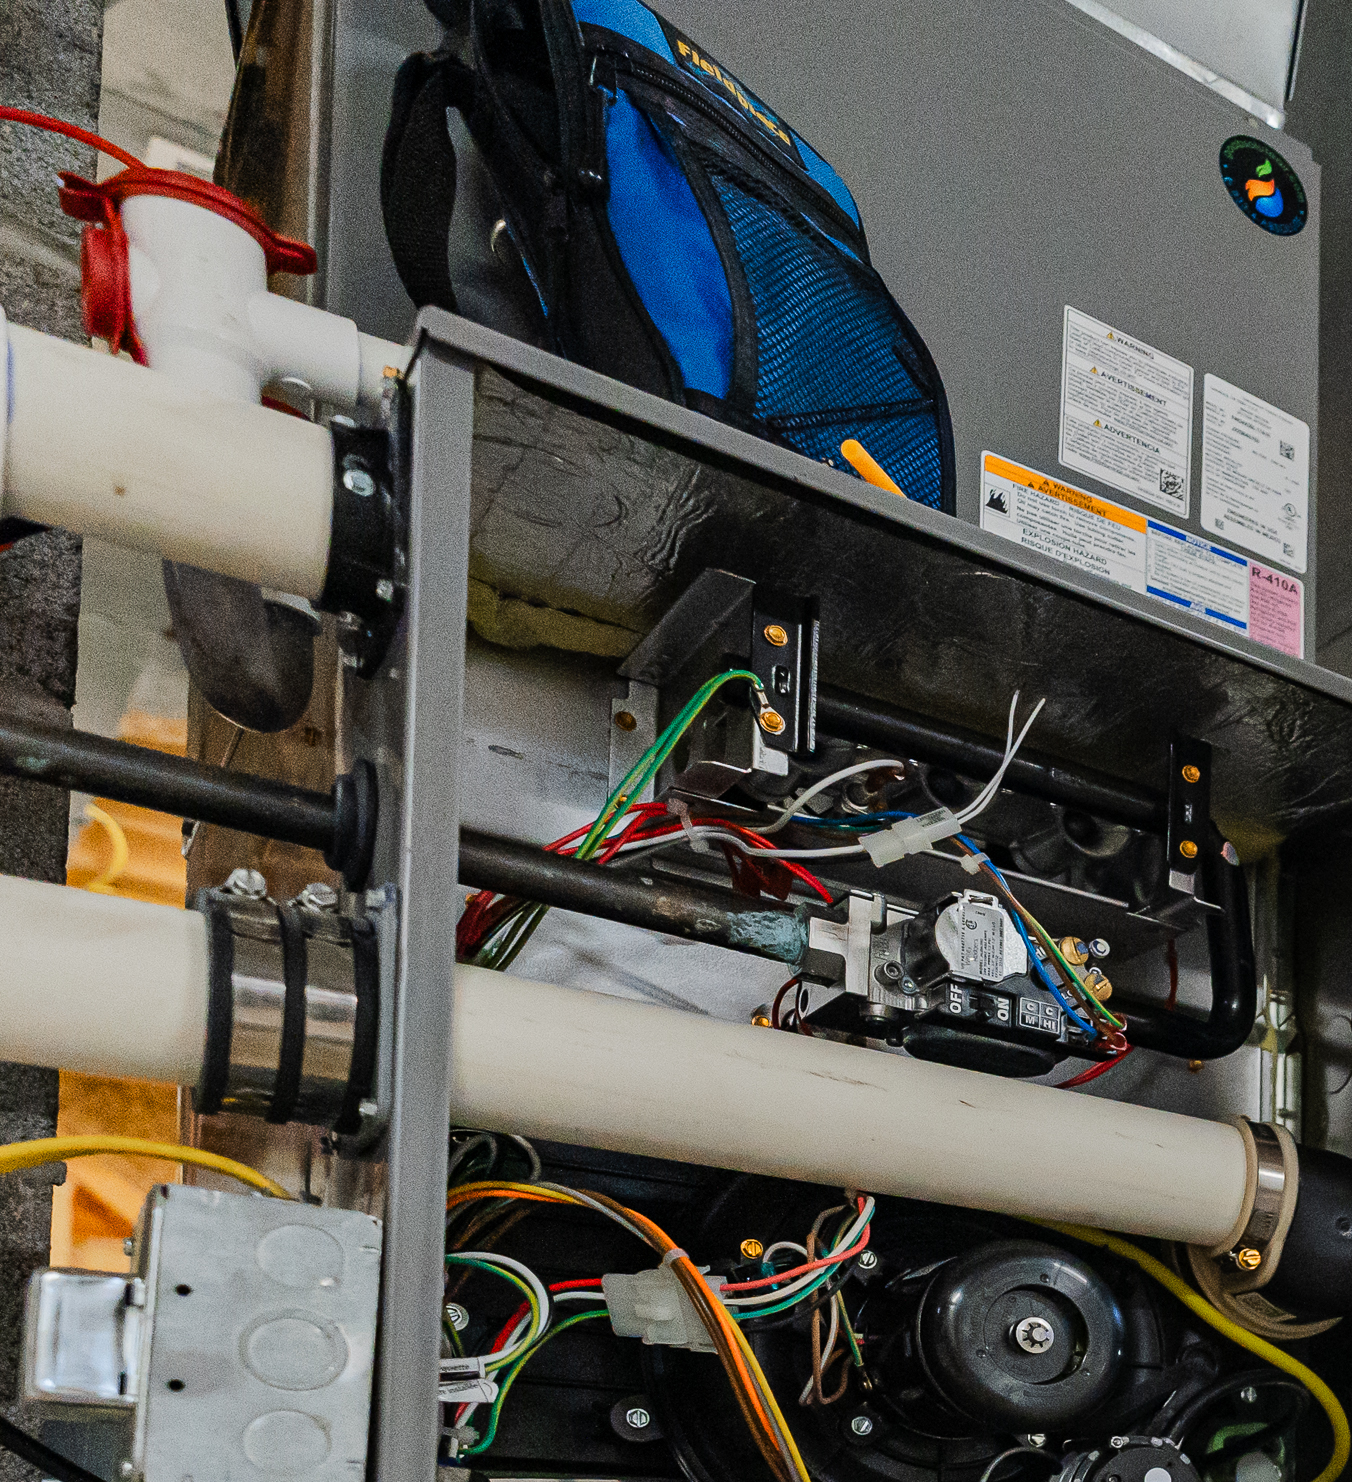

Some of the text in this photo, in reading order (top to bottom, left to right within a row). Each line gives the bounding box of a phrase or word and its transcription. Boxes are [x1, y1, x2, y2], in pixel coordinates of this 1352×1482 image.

[677, 40, 790, 146] Fieldpiece
[1104, 423, 1160, 453] ADVERTENCIA
[1038, 484, 1106, 517] AVERTISSEMENT
[1053, 482, 1092, 503] WARNING
[1021, 536, 1053, 554] RISQUE
[1056, 549, 1111, 575] D'EXPLOSION
[1022, 527, 1107, 566] EXPLOSION HAZARD
[1252, 566, 1298, 595] R-410A
[949, 984, 962, 1014] OFF
[997, 997, 1010, 1021] ON
[1026, 1002, 1053, 1015] C C
[1025, 1015, 1055, 1030] M HI
